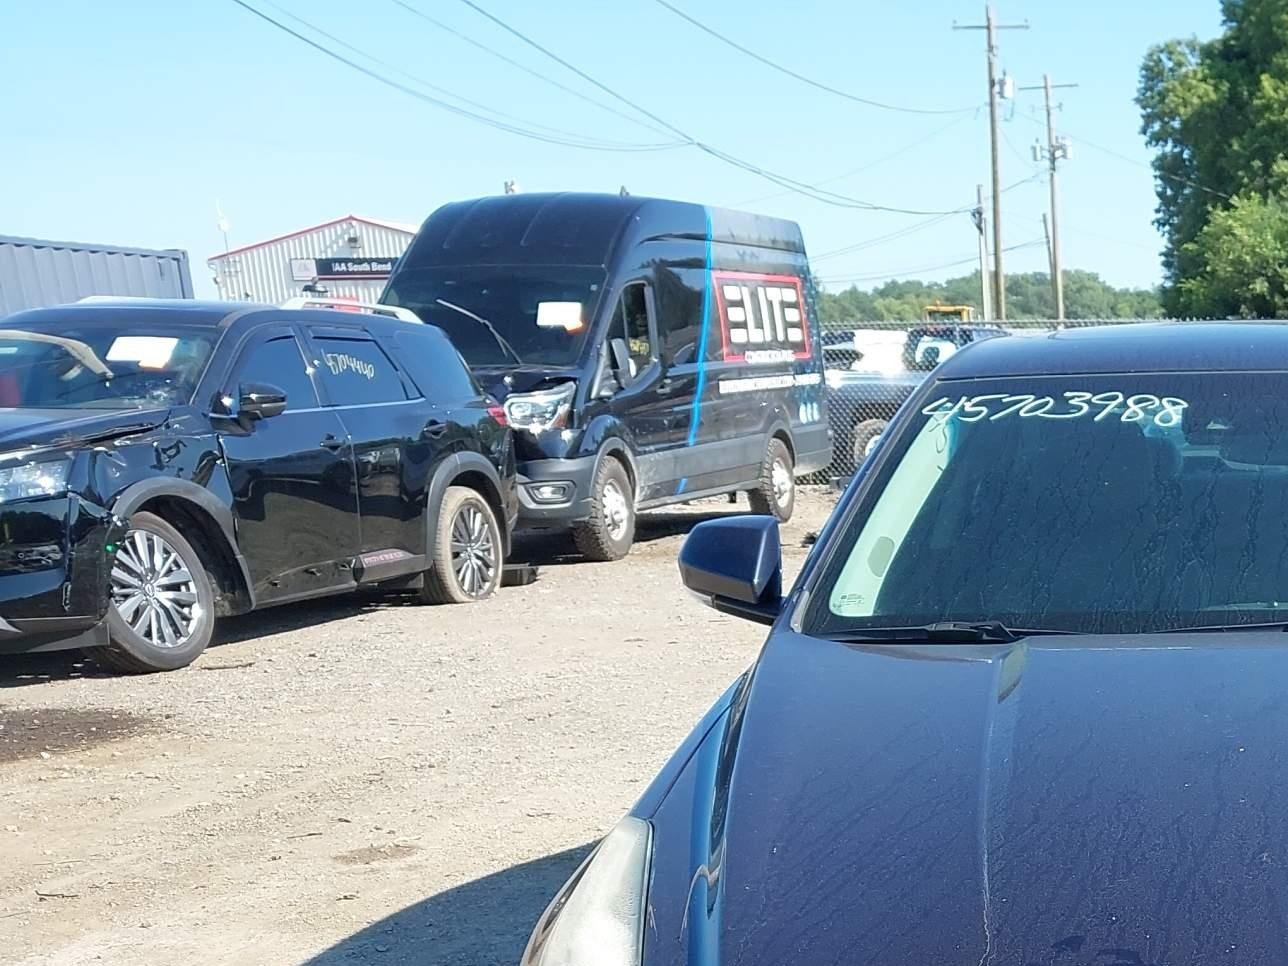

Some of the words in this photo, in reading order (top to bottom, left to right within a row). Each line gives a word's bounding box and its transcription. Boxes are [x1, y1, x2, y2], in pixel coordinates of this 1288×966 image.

[331, 262, 347, 273] IAA
[347, 261, 371, 272] South
[371, 261, 392, 272] Bend
[722, 284, 803, 344] ELITE
[921, 391, 1189, 427] 45703988
